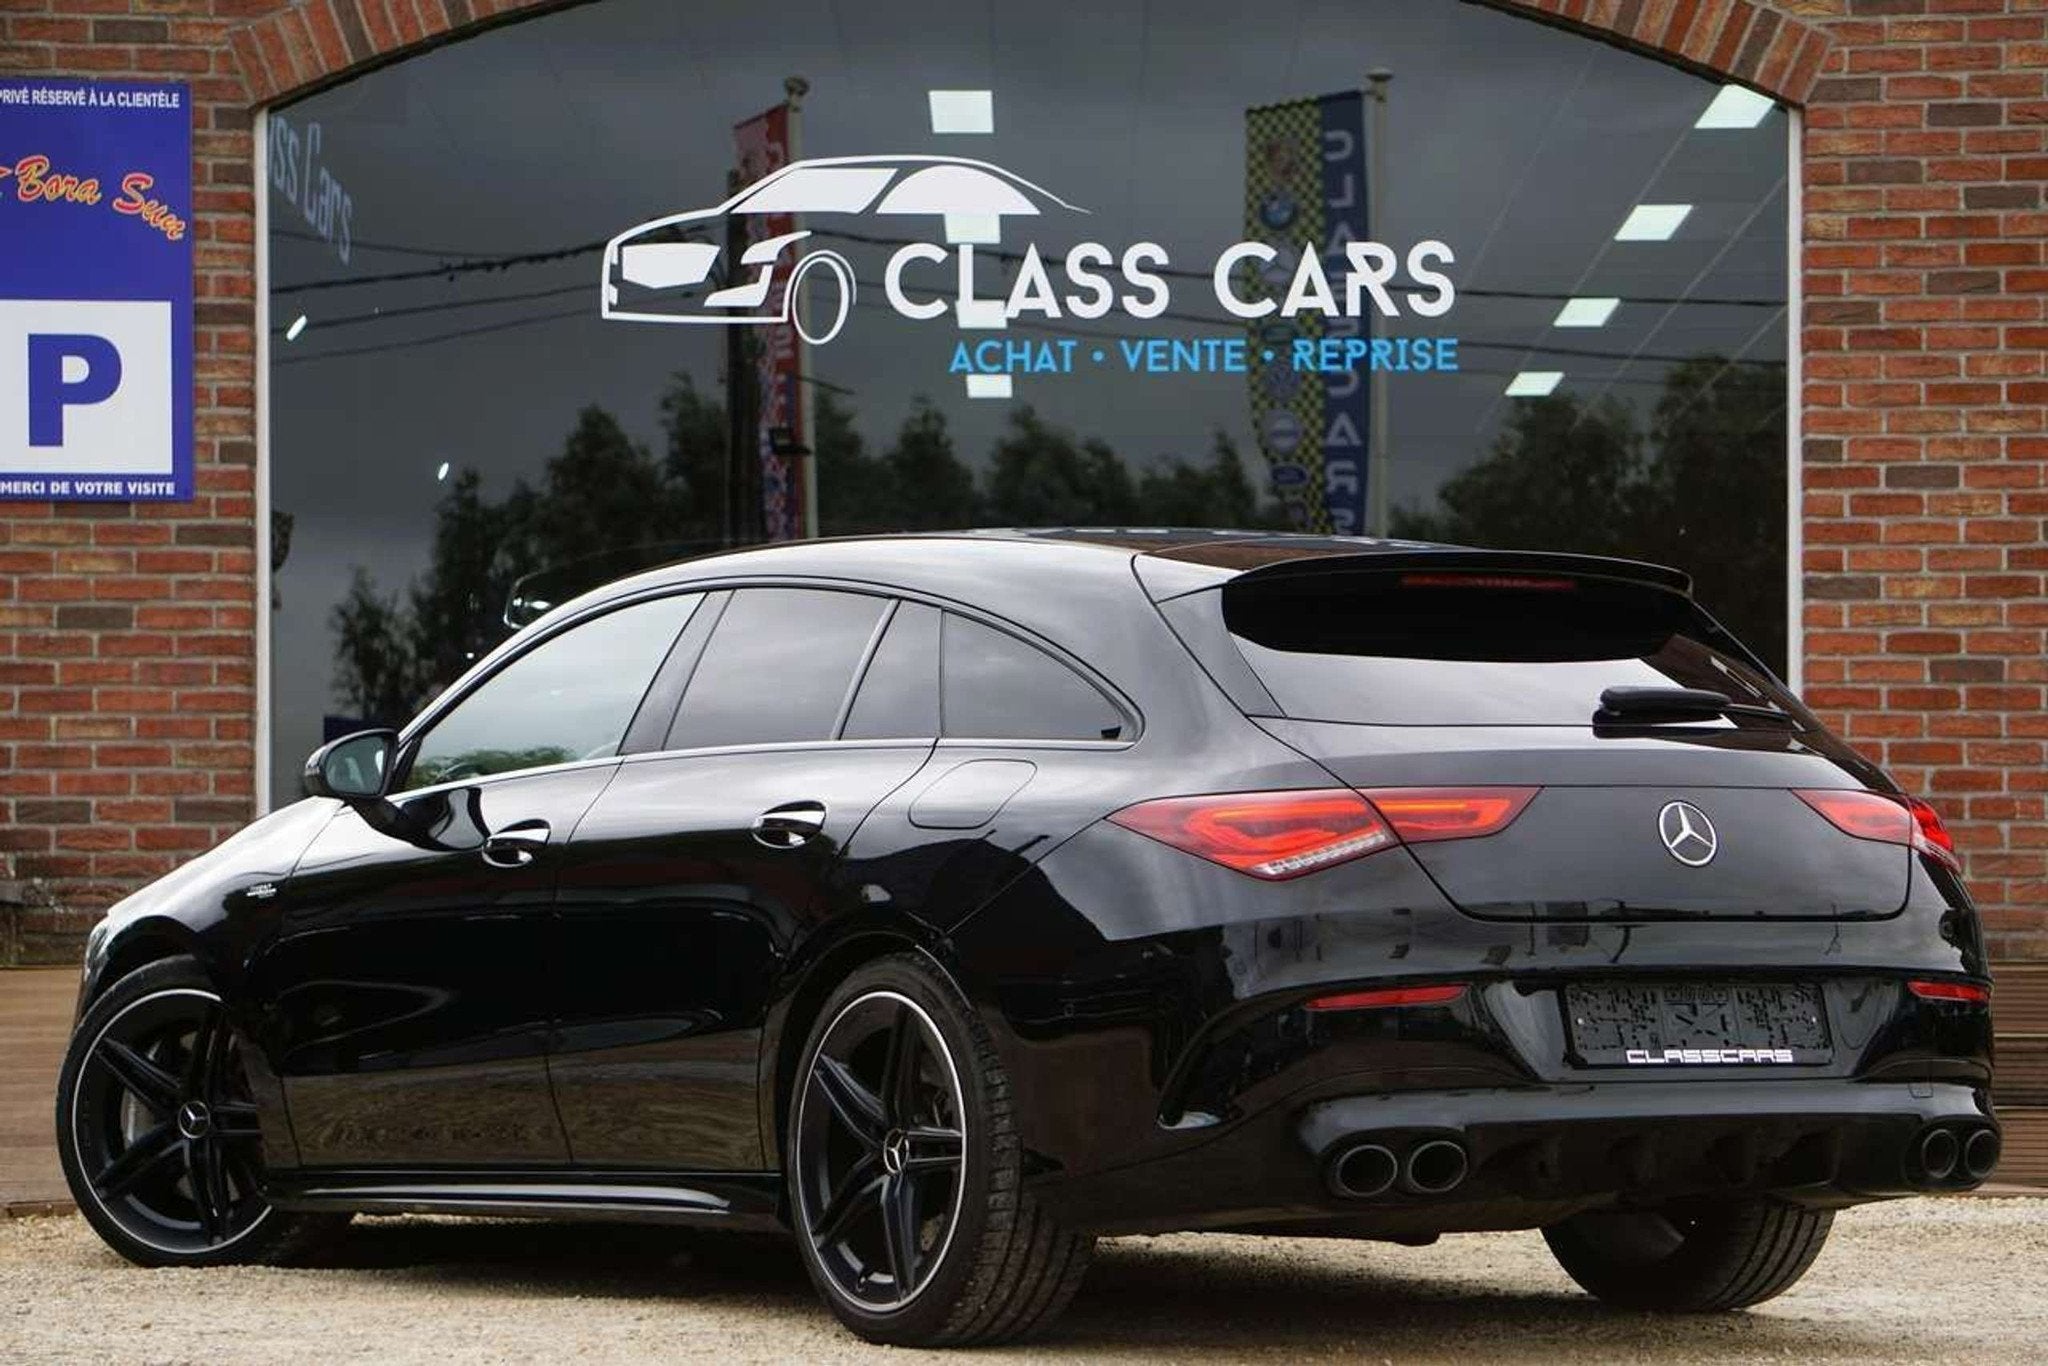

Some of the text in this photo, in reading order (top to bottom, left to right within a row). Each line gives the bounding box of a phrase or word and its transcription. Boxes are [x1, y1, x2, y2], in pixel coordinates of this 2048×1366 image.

[32, 86, 86, 106] RÉSERVÉ
[88, 87, 98, 106] À
[100, 91, 116, 107] LA
[117, 90, 180, 108] CLIENTÈLE
[15, 154, 102, 205] Bora
[884, 240, 1456, 319] CLASS CARS
[949, 337, 1459, 374] ACHAT VENTE REPRISE
[28, 333, 123, 447] P
[0, 481, 175, 496] MERCI DE VOTRE VISITE
[1625, 1049, 1794, 1064] CLASSCARS
